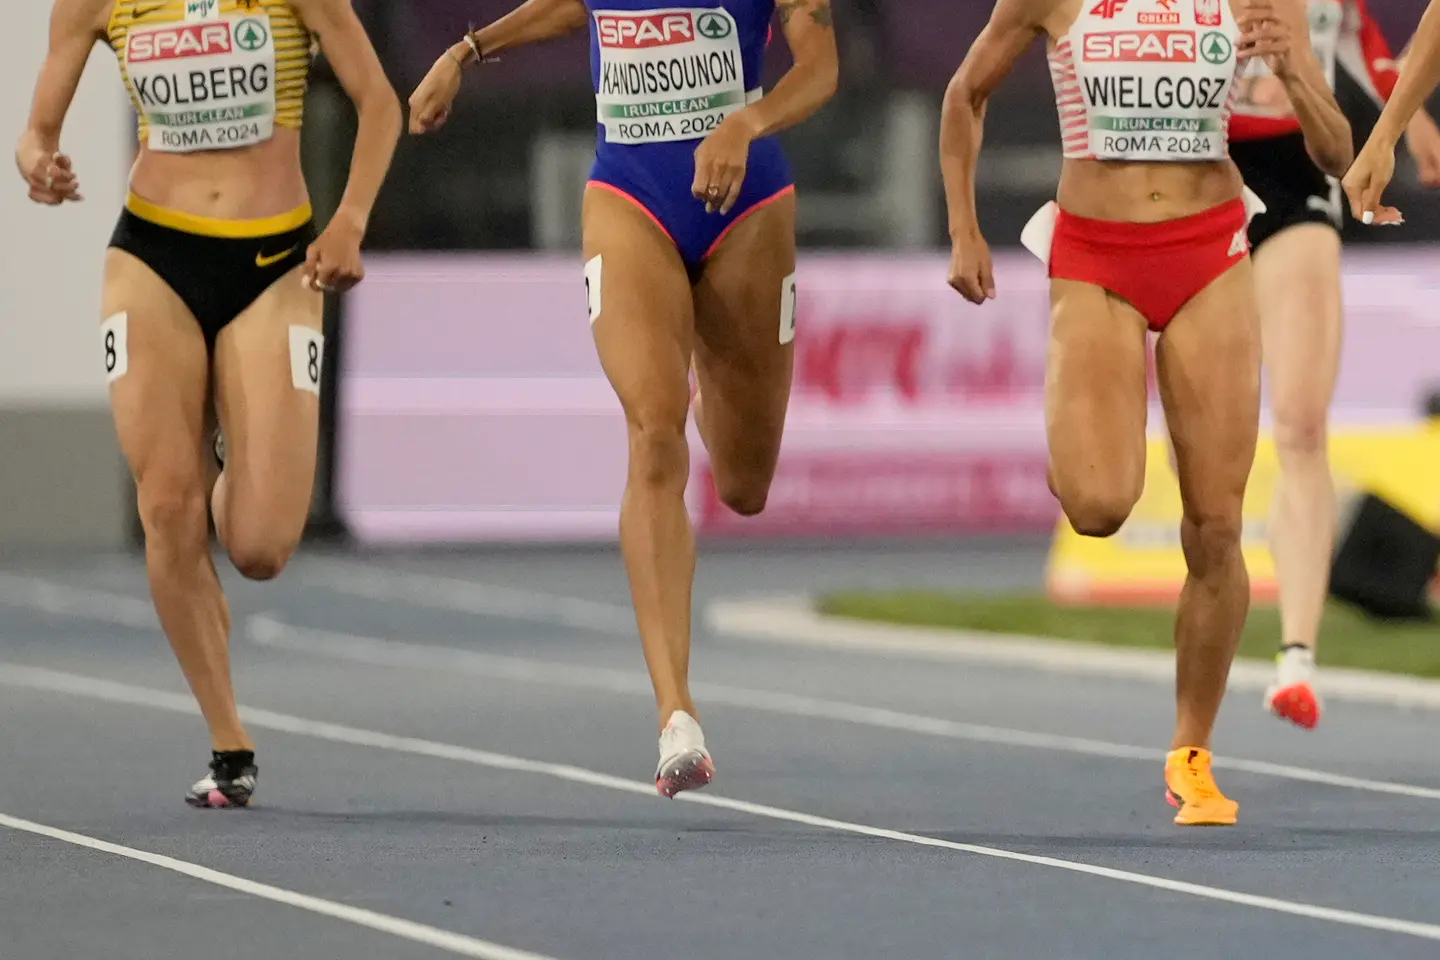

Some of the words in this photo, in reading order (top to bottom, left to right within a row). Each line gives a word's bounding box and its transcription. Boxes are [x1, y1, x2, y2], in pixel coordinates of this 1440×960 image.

[600, 16, 691, 45] SPAR
[1139, 13, 1178, 24] ORLEN
[130, 23, 229, 60] SPAR
[1085, 33, 1194, 58] SPAR
[134, 63, 268, 107] KOLBERG
[603, 50, 736, 95] KANDISSOUNON
[1084, 76, 1226, 109] WIELGOSZ
[630, 102, 661, 117] RUN
[162, 128, 212, 147] ROMA
[216, 122, 259, 143] 2024
[619, 121, 676, 139] ROMA
[680, 112, 725, 135] 2024
[1119, 119, 1151, 130] RUN
[1153, 118, 1200, 131] CLEAN
[1104, 137, 1161, 152] ROMA
[1167, 136, 1211, 152] 2024
[105, 330, 116, 372] 8
[308, 341, 318, 383] 8
